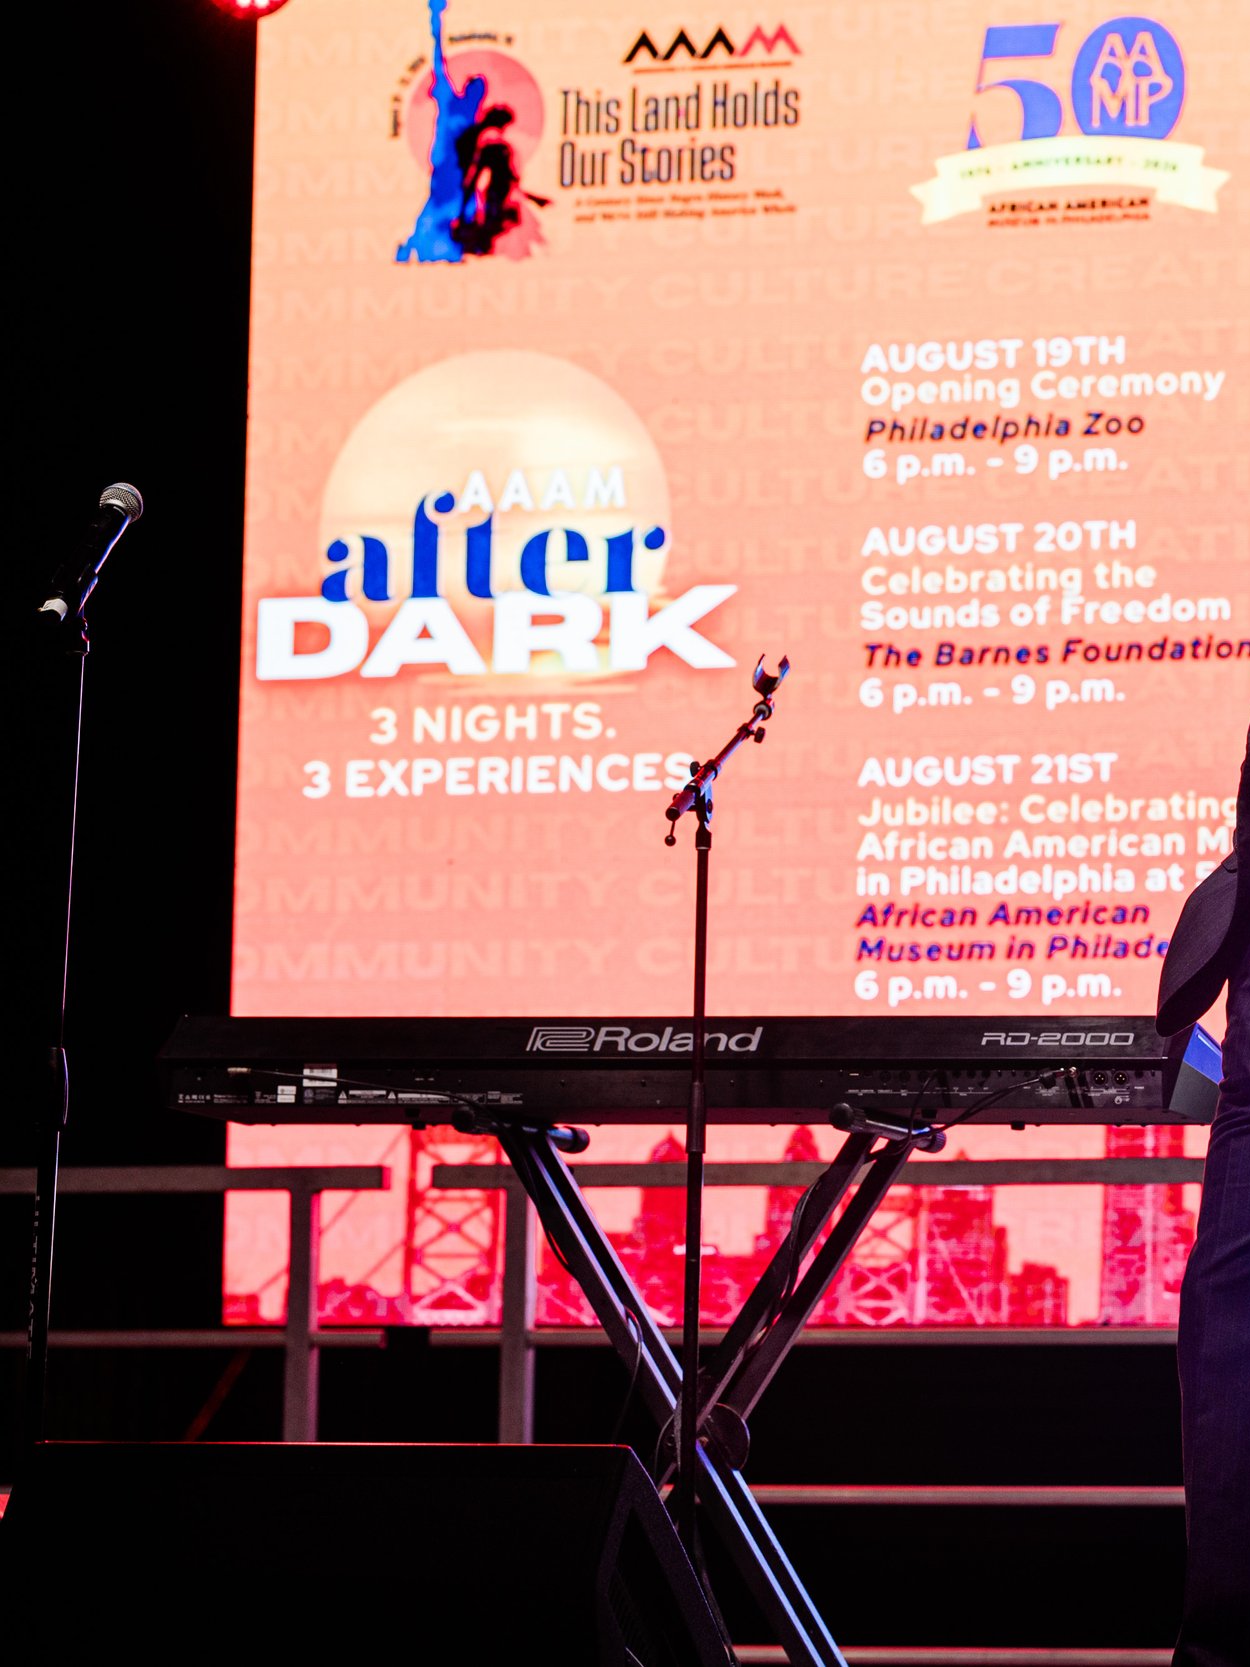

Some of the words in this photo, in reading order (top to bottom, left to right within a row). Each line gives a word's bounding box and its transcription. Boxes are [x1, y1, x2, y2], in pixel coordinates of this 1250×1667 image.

[624, 25, 802, 63] AAAM
[560, 89, 620, 135] This
[631, 84, 701, 132] Land
[713, 80, 800, 128] Holds
[559, 141, 608, 188] Our
[620, 137, 736, 185] Stories
[988, 201, 1057, 214] AFRICAN
[1064, 196, 1150, 210] AMERICAN
[861, 340, 1023, 373] AUGUST
[1033, 336, 1126, 368] 19TH
[861, 374, 1020, 411] Opening
[1030, 370, 1225, 400] Ceremony
[864, 413, 1071, 444] Philadelphia
[1083, 411, 1145, 437] Zoo
[862, 449, 887, 478] 6
[896, 450, 976, 485] p.m.
[1014, 444, 1038, 474] 9
[1048, 446, 1128, 480] p.m.
[460, 466, 626, 511] AAAM
[321, 490, 666, 603] after
[861, 523, 1023, 557] AUGUST
[1034, 520, 1137, 552] 20TH
[861, 562, 1082, 595] Celebrating
[1093, 560, 1157, 589] the
[860, 599, 999, 630] Sounds
[1010, 596, 1051, 626] of
[1061, 594, 1231, 625] Freedom
[256, 584, 739, 681] DARK
[864, 643, 922, 668] The
[934, 641, 1050, 666] Barnes
[859, 677, 884, 706] 6
[893, 679, 972, 713] p.m.
[1010, 675, 1035, 704] 9
[1046, 676, 1126, 710] p.m.
[370, 707, 398, 745] 3
[413, 702, 617, 743] NIGHTS.
[302, 761, 331, 799] 3
[345, 752, 694, 797] EXPERIENCES
[857, 755, 1020, 787] AUGUST
[1031, 753, 1118, 784] 21ST
[858, 796, 1008, 827] Jubilee:
[1020, 790, 1237, 828] Celebrating
[857, 831, 993, 861] African
[1004, 828, 1185, 860] American
[1197, 825, 1235, 855] M
[857, 865, 890, 896] in
[901, 860, 1135, 900] Philadelphia
[1145, 862, 1184, 892] at
[856, 903, 977, 928] African
[989, 901, 1150, 927] American
[856, 937, 995, 962] Museum
[1006, 935, 1035, 961] in
[854, 971, 879, 1000] 6
[888, 971, 968, 1007] p.m.
[1007, 968, 1032, 999] 9
[1042, 969, 1122, 1005] p.m.
[593, 1026, 763, 1052] Roland
[981, 1031, 1135, 1046] RD-2000
